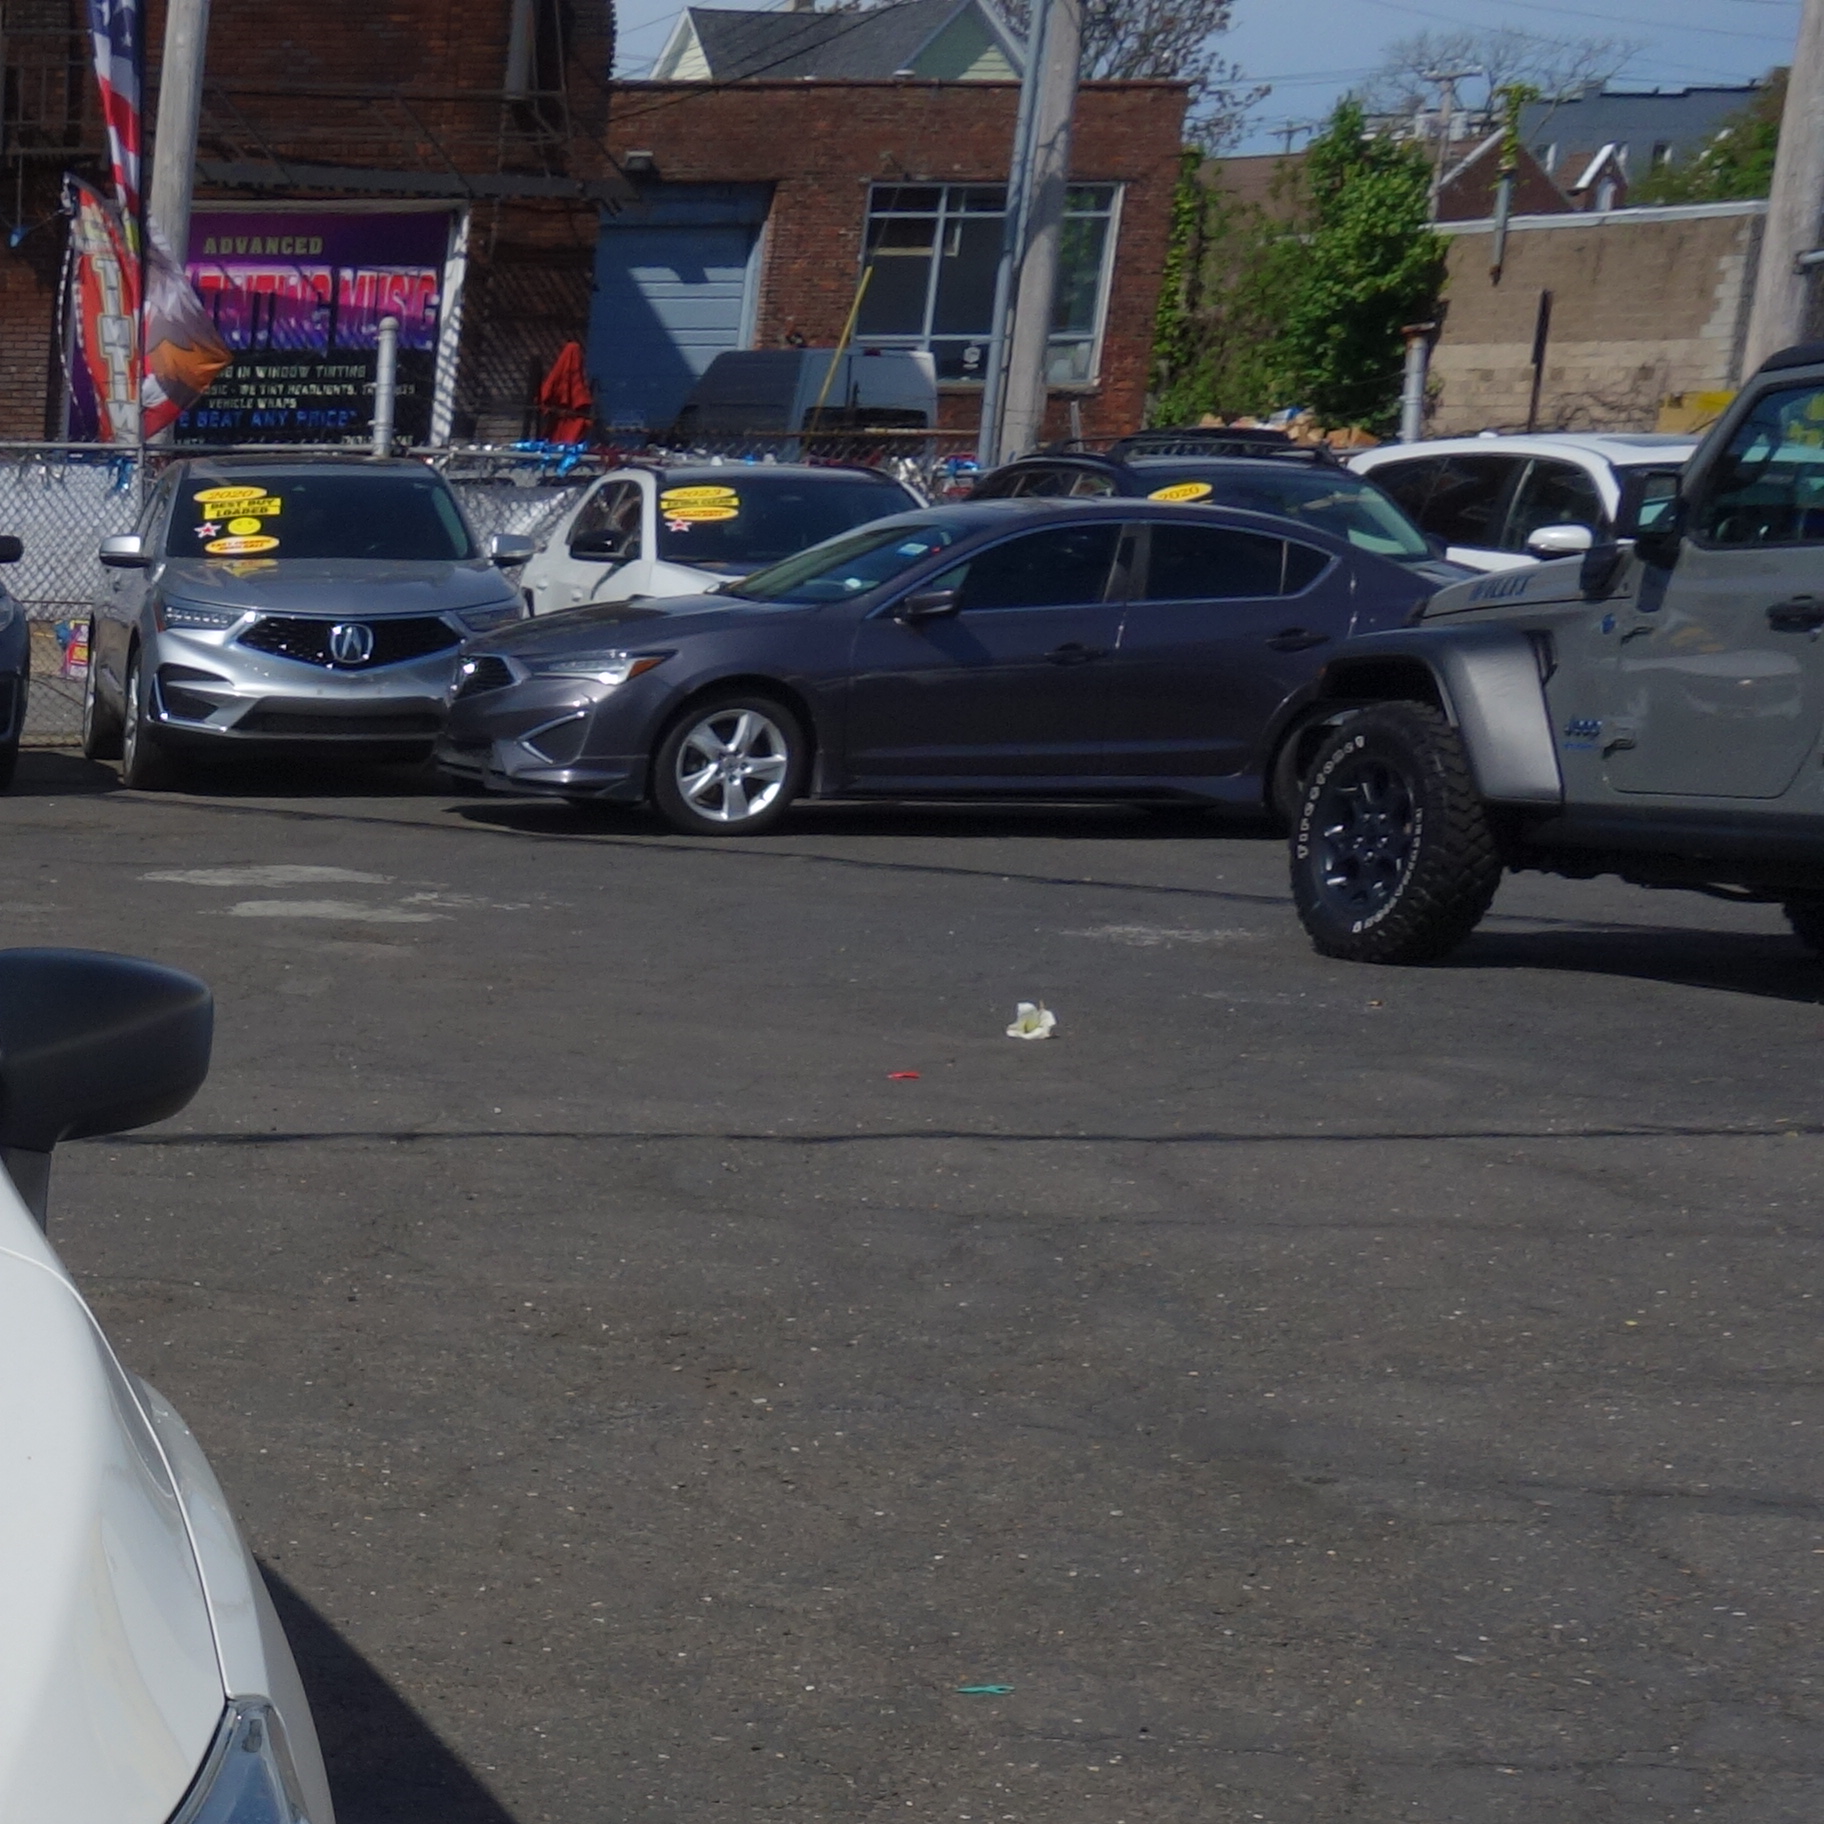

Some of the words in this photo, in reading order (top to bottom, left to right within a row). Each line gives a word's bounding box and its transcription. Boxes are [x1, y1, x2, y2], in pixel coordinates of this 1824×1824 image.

[204, 237, 324, 255] ADVANCED
[337, 263, 440, 350] MUSIC
[237, 365, 252, 379] IN
[256, 364, 310, 379] WINDOW
[315, 364, 367, 379] TINTING
[209, 399, 253, 409] VEHICLE
[257, 398, 298, 409] WRAPS
[196, 410, 243, 428] BEAT
[251, 410, 289, 428] ANY
[207, 489, 254, 500] 2020
[1159, 485, 1200, 500] 2020
[211, 500, 242, 509] BEST
[216, 507, 269, 517] LOADED
